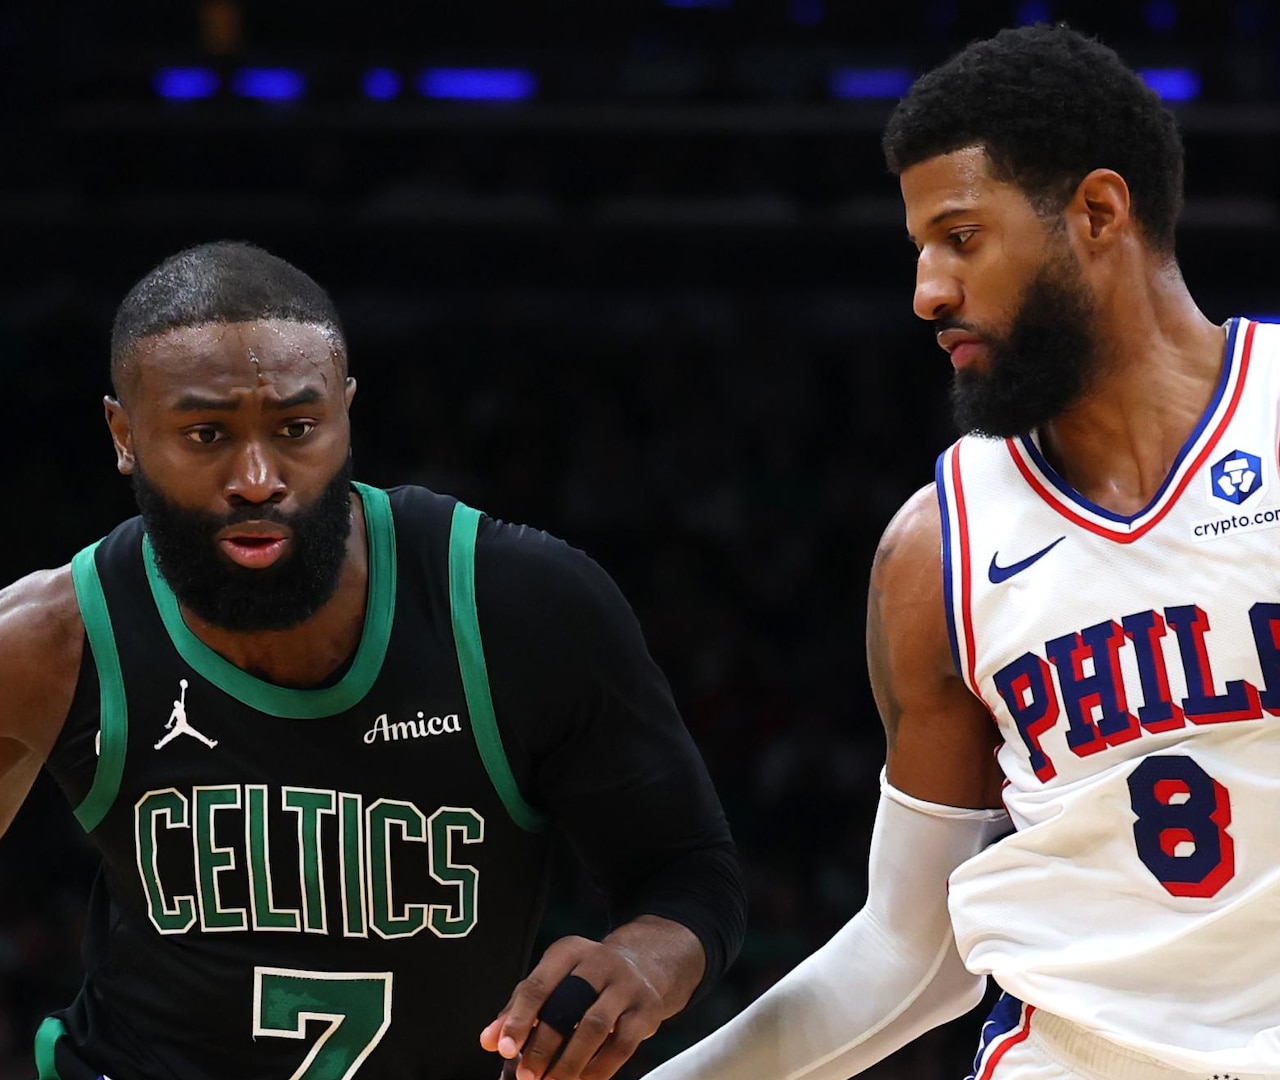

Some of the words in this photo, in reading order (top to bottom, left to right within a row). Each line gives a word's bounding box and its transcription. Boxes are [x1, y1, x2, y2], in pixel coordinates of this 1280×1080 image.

[363, 710, 463, 745] Amica
[134, 783, 485, 939] CELTICS
[1126, 754, 1236, 899] 8
